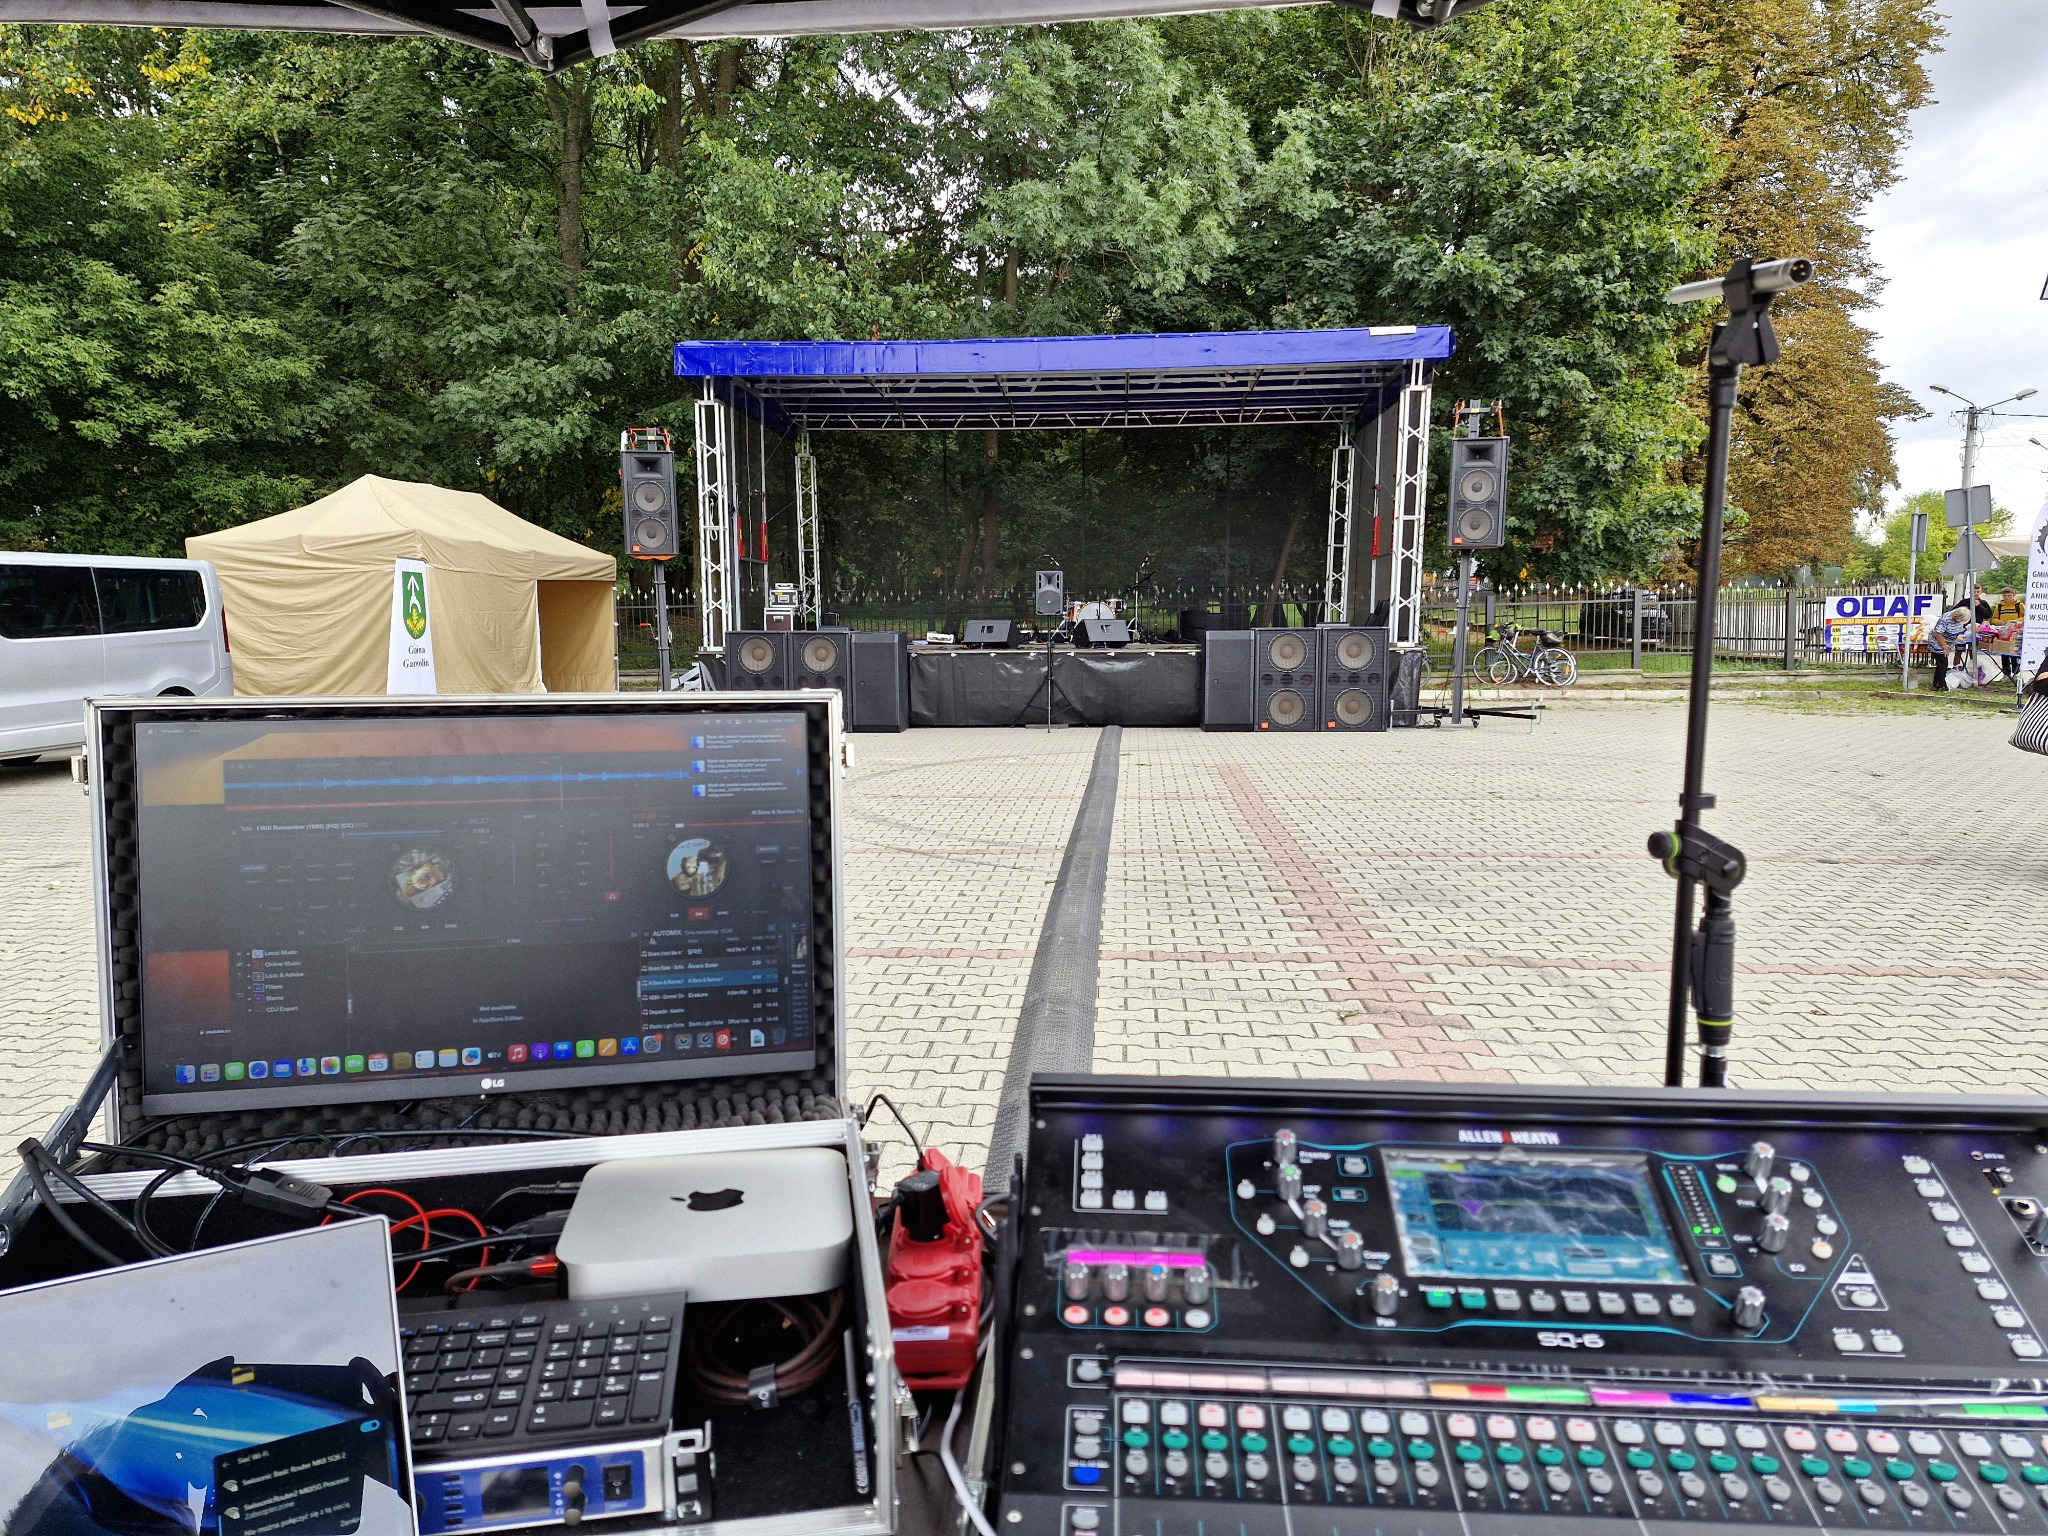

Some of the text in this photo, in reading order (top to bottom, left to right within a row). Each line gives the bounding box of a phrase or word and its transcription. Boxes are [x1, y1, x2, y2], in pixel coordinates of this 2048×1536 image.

[1836, 596, 1932, 618] OLAF
[372, 1060, 384, 1069] 15
[1537, 1330, 1605, 1349] SQ-6
